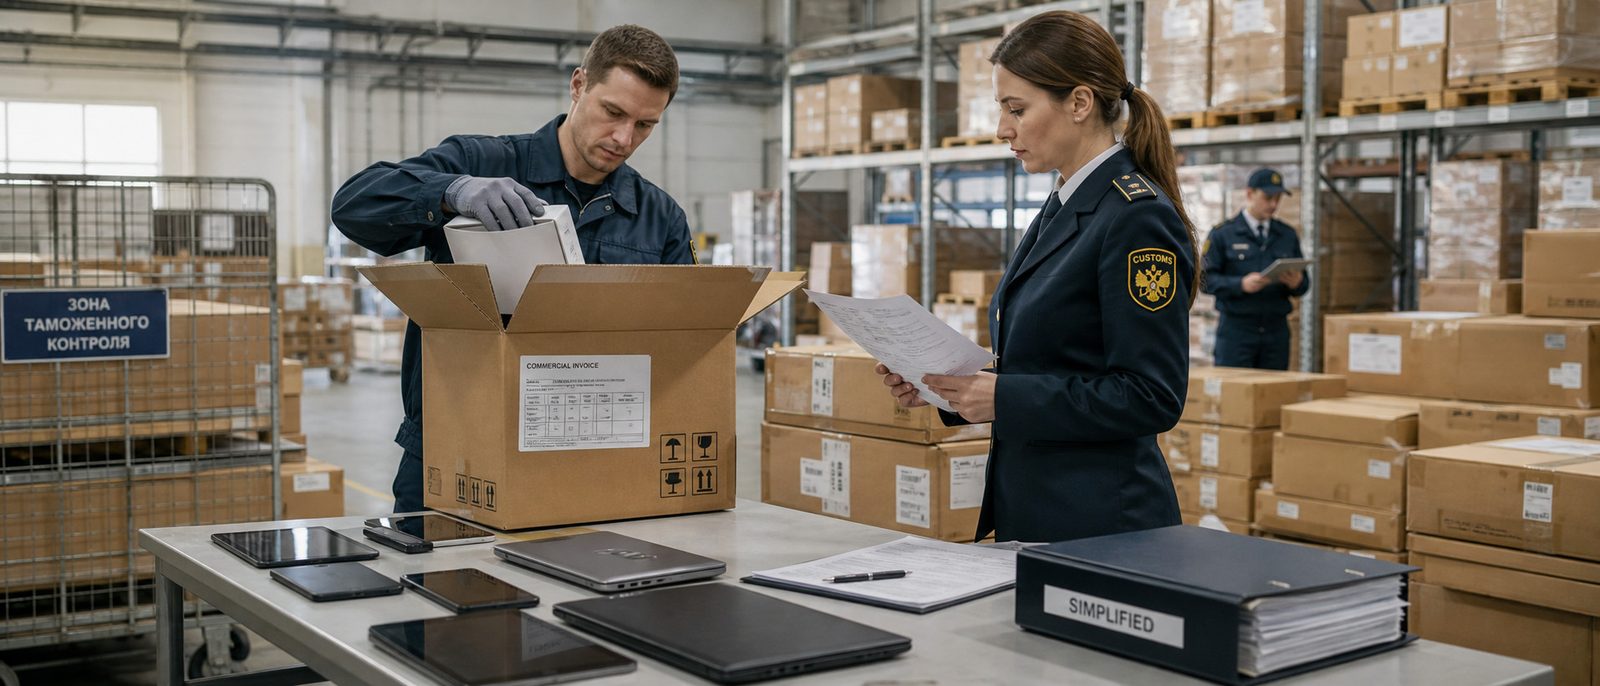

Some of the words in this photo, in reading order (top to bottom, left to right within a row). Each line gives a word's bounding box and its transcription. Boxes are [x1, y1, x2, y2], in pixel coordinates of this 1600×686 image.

[1132, 254, 1173, 265] CUSTOMS
[68, 297, 110, 311] ЗОНА
[25, 316, 149, 332] ТАМОЖЕННОГО
[47, 336, 130, 351] КОНТРОЛЯ
[1069, 597, 1154, 633] SIMPLIFIED
